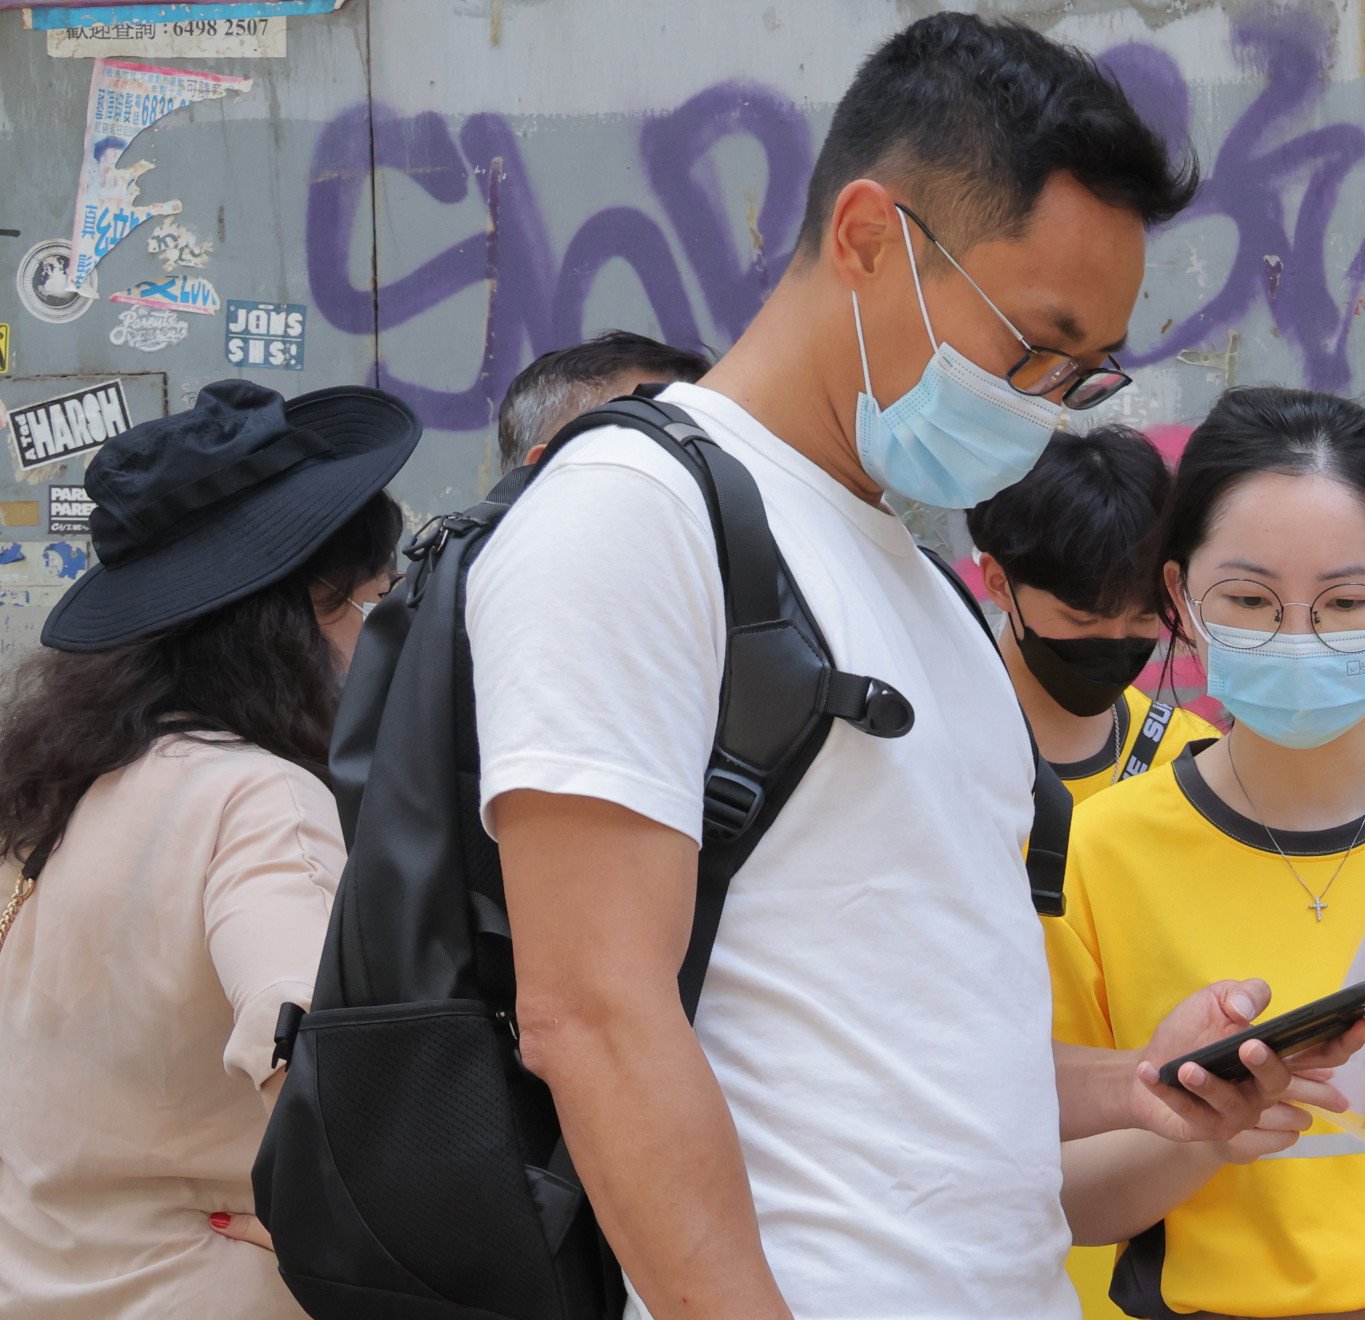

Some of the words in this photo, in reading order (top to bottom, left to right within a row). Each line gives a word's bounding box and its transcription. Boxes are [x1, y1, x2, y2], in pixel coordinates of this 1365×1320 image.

[173, 20, 217, 37] 6498
[225, 18, 269, 36] 2507
[26, 387, 127, 459] HARSH
[51, 502, 99, 516] PARE
